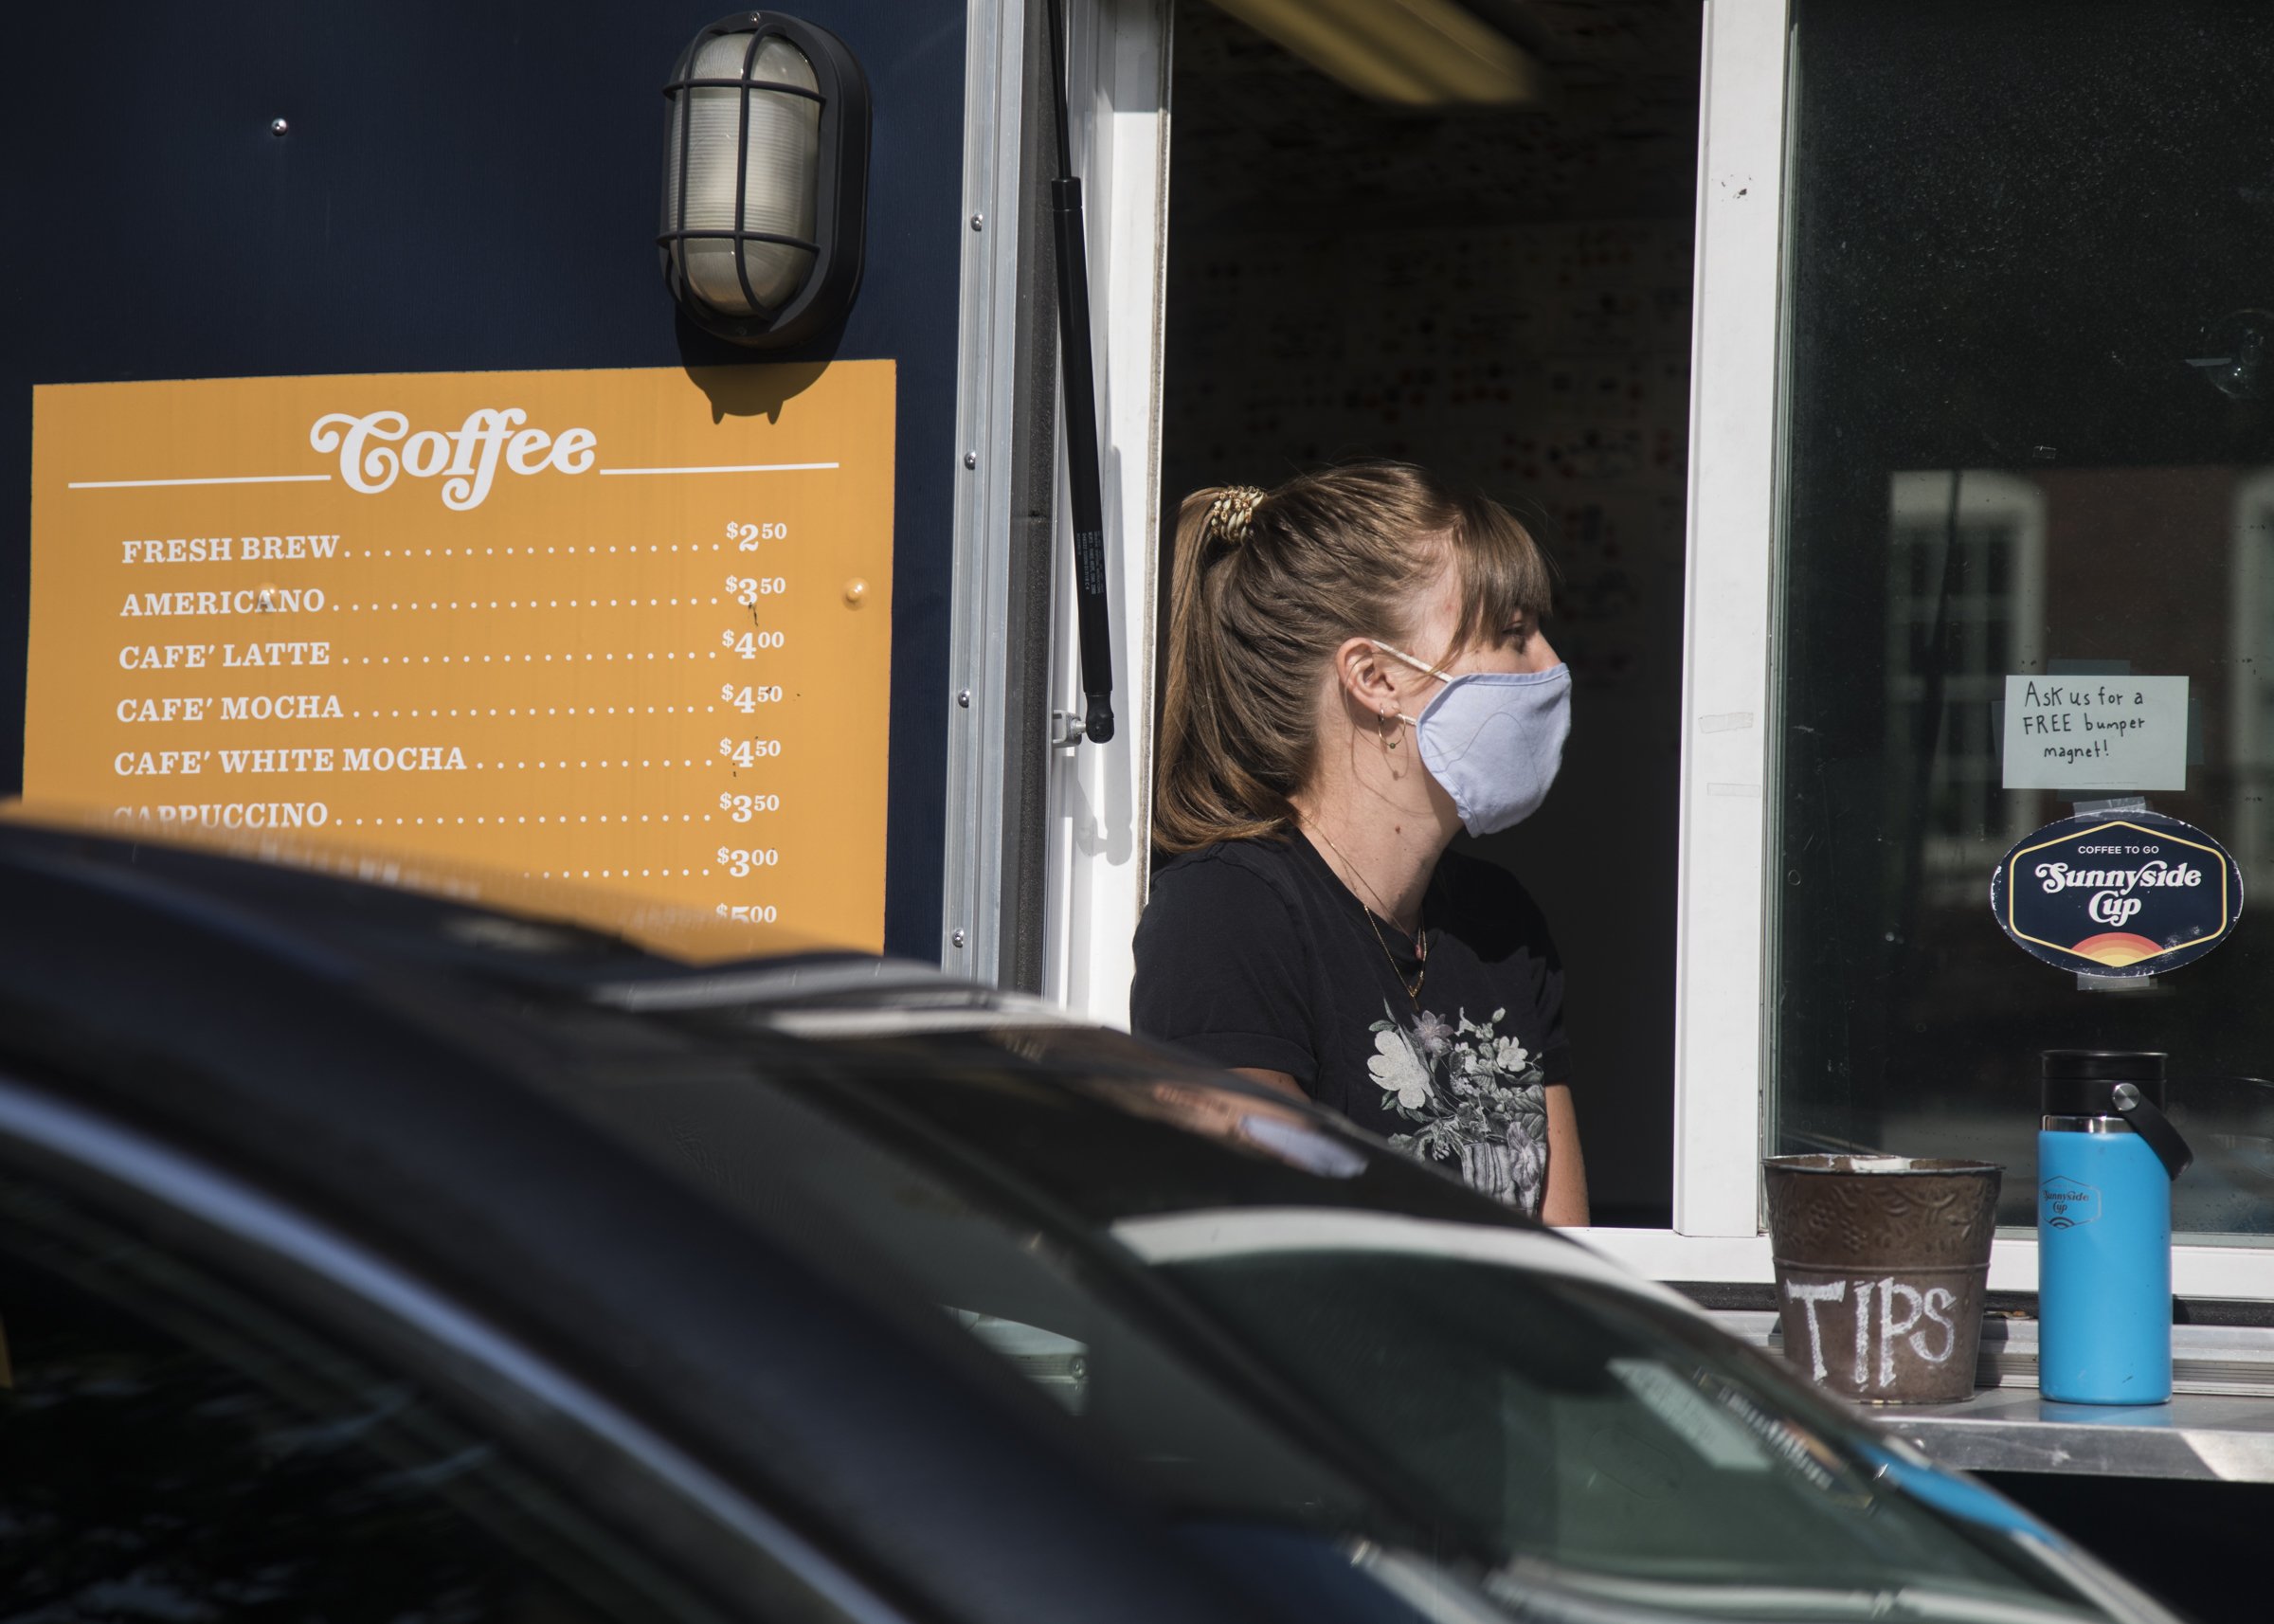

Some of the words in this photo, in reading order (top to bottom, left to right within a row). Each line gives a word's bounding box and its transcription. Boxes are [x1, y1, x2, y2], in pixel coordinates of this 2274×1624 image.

[309, 407, 598, 512] Coffee
[121, 537, 232, 564] FRESH
[241, 534, 340, 560] BREW
[119, 587, 326, 617] AMERICANO
[223, 641, 331, 668] LATTE
[220, 695, 344, 721] MOCHA
[2069, 692, 2090, 706] us
[2098, 686, 2123, 706] for
[2134, 692, 2143, 705] a
[2023, 713, 2072, 735] FREE
[2084, 712, 2145, 737] bumper
[218, 748, 334, 774] WHITE
[342, 745, 468, 772] MOCHA
[2044, 739, 2109, 765] magnet!
[2077, 845, 2122, 855] COFFEE
[2124, 845, 2140, 855] TO
[2142, 845, 2159, 855] GO
[2034, 859, 2202, 895] Sunnyside
[2088, 890, 2141, 928] Cup
[1785, 1276, 1958, 1393] TIPS
